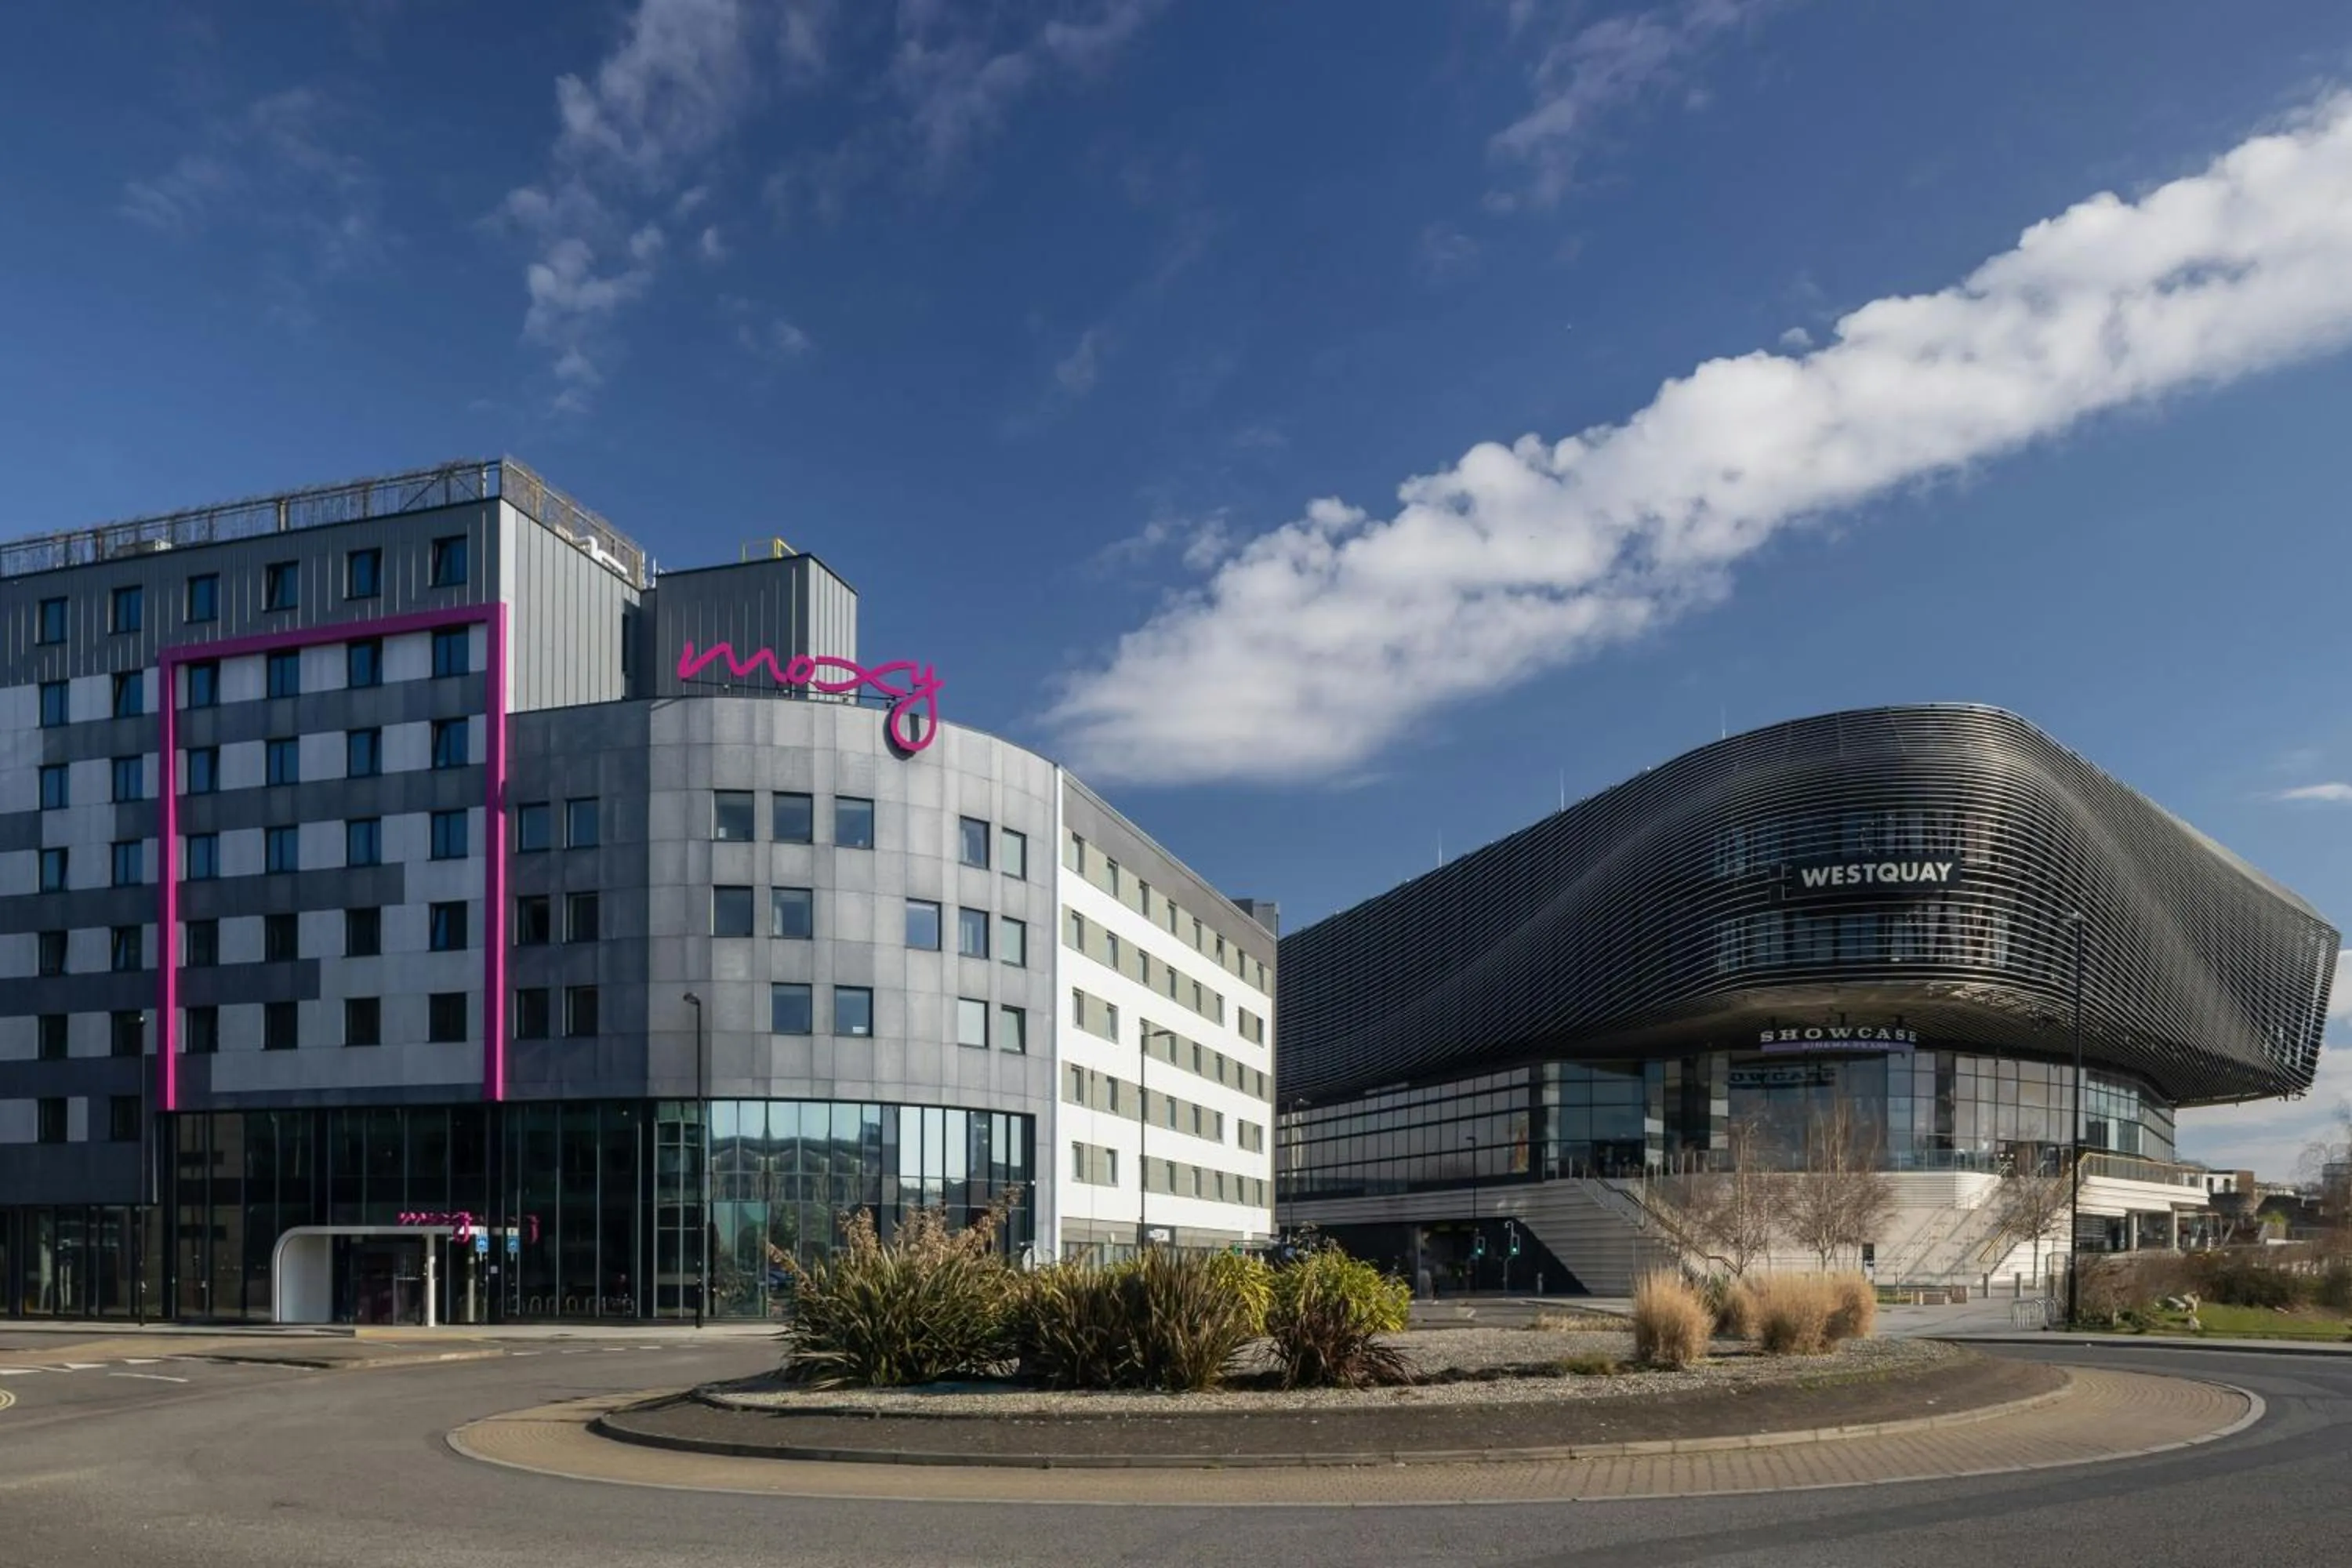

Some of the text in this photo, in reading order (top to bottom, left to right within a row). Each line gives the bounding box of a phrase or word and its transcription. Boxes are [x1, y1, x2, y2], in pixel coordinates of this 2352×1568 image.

[677, 641, 945, 752] moxy
[1802, 862, 1953, 888] WESTQUAY
[1760, 1027, 1917, 1043] SHOWCASE
